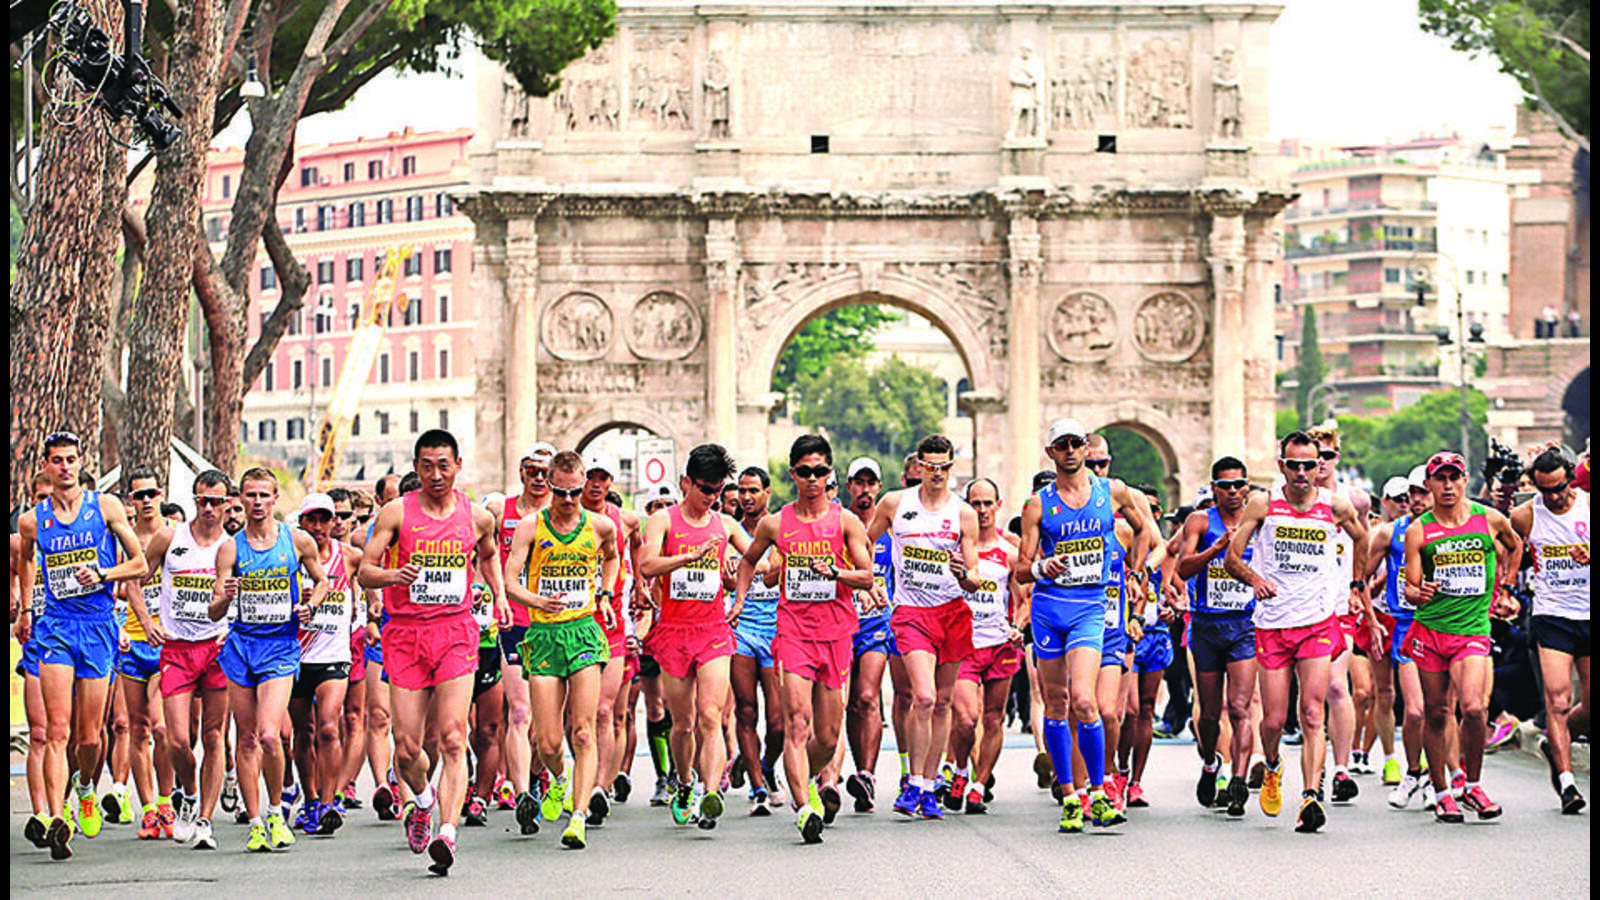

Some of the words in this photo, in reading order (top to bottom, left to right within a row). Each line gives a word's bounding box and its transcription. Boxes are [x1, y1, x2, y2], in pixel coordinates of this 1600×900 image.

[1061, 518, 1101, 536] ITALIA
[1275, 526, 1326, 541] SEIKO
[51, 531, 93, 551] ITALIA
[1055, 539, 1101, 554] SEIKO
[47, 550, 95, 567] SEIKO
[411, 554, 466, 568] SEIKO
[904, 546, 948, 562] SEIKO
[1434, 552, 1483, 566] SEIKO
[541, 565, 588, 577] SEIKO
[904, 560, 944, 575] SIKORA
[425, 571, 451, 583] HAN
[687, 571, 705, 583] LIU
[242, 579, 289, 591] SEIKO
[541, 579, 586, 592] TALLENT
